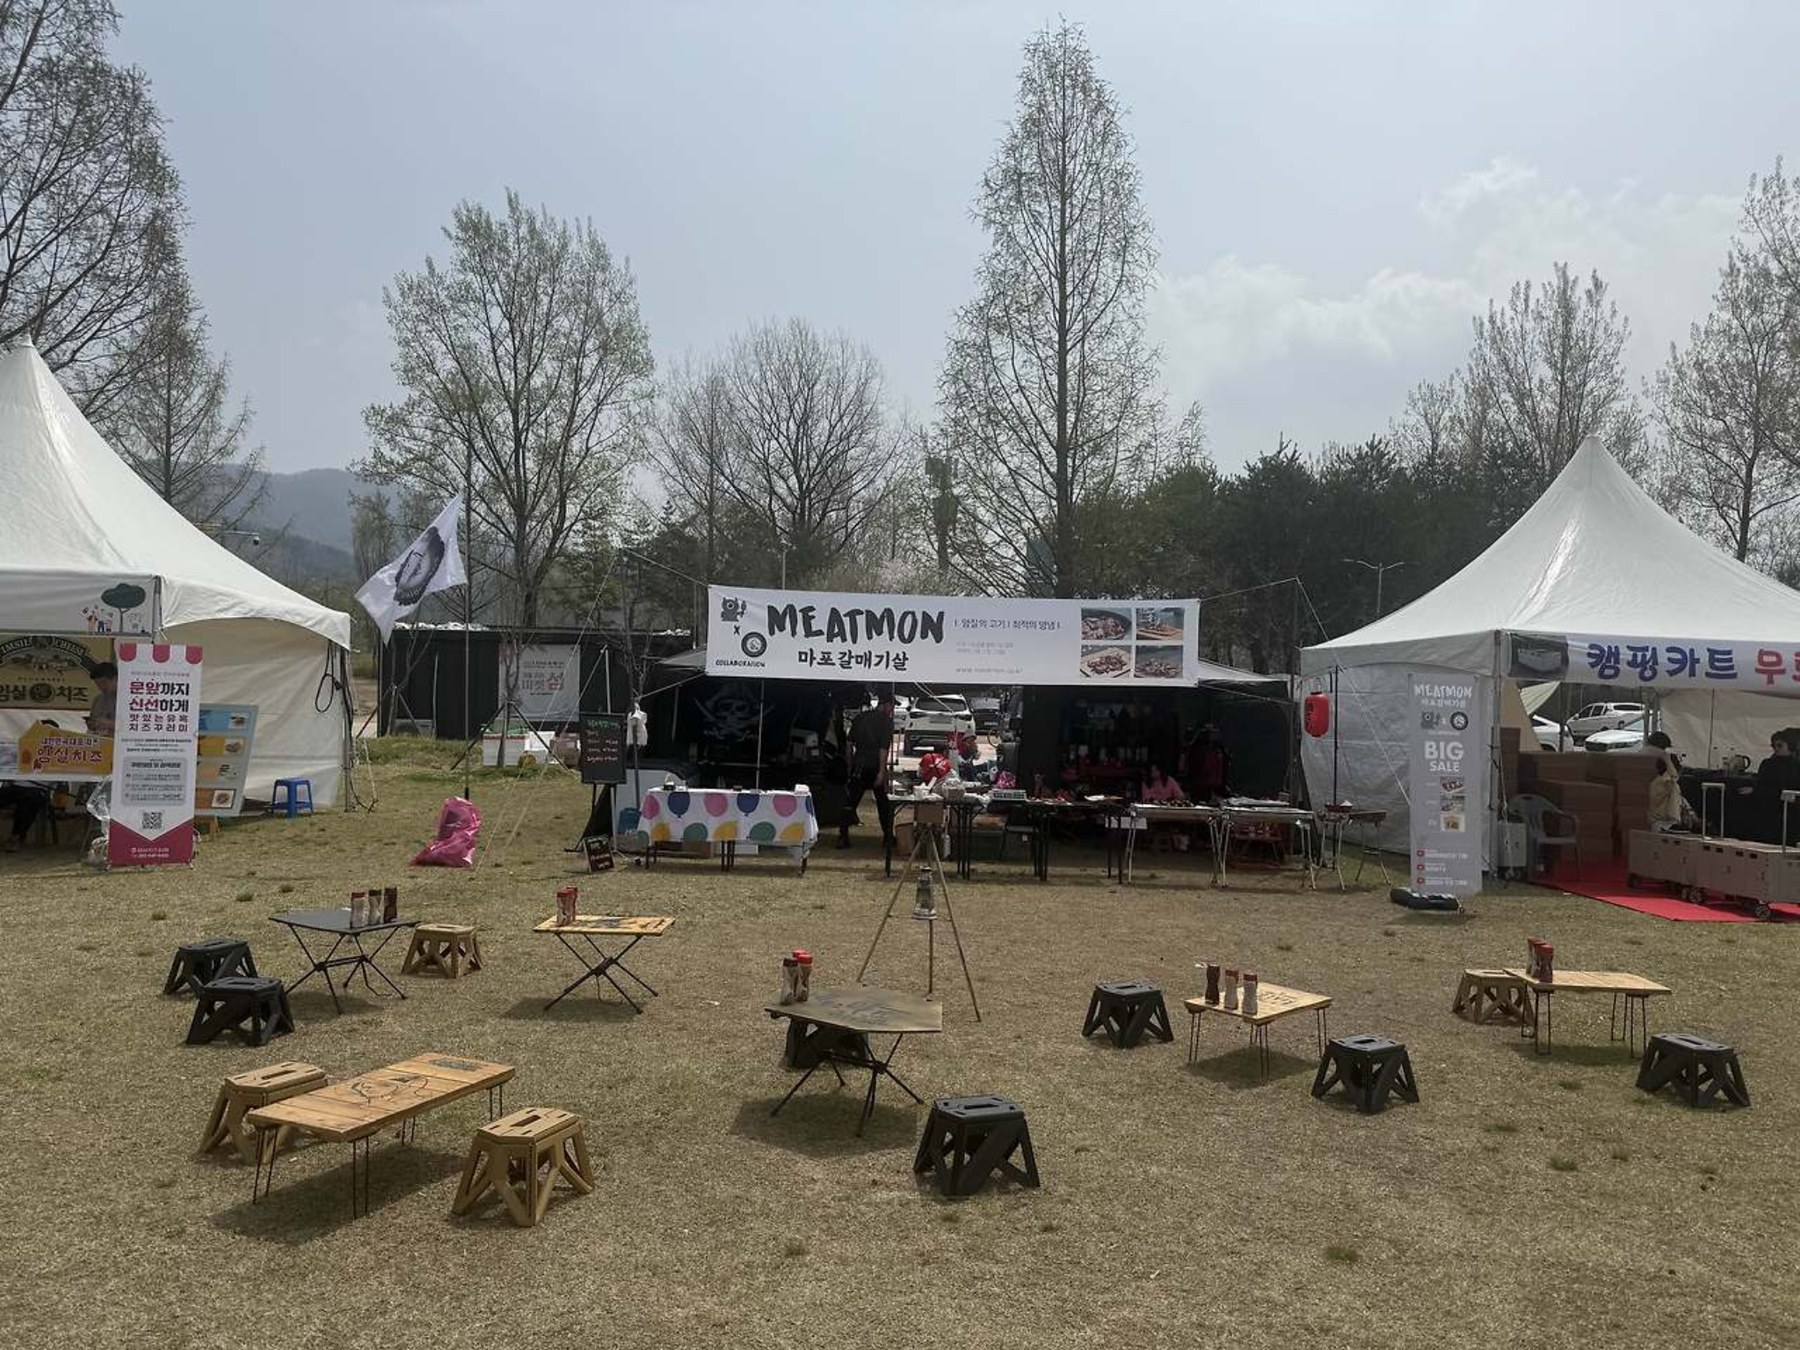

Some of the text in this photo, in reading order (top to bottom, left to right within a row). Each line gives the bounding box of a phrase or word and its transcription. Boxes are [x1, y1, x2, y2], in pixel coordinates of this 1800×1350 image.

[767, 604, 945, 644] MEATMON
[715, 658, 766, 668] COLLABORATION
[798, 648, 909, 671] 마포갈매기살
[1587, 644, 1800, 685] 캠핑카트 무
[129, 680, 190, 696] 문앞까지
[1414, 684, 1472, 698] MEATMON
[129, 698, 189, 712] 신선하게
[1425, 741, 1464, 760] BIG
[1430, 760, 1460, 772] SALE
